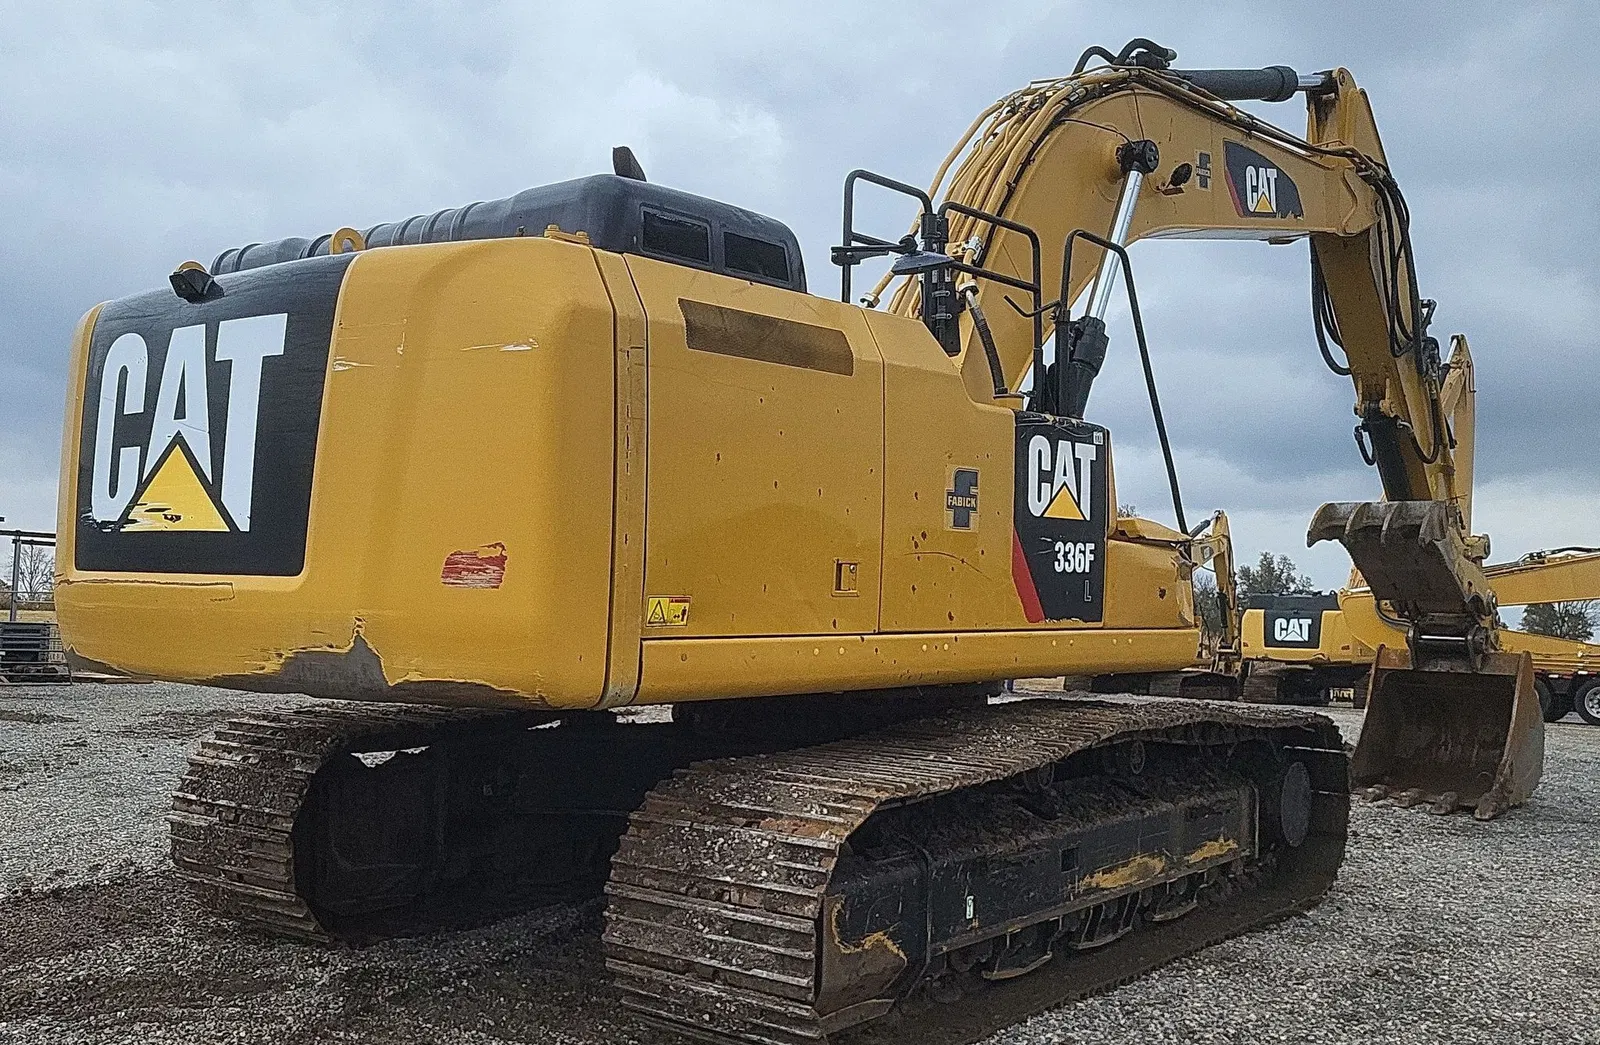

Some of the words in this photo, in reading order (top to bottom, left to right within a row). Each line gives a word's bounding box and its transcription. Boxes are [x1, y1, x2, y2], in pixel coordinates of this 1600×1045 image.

[1245, 166, 1278, 213] CAT
[90, 313, 288, 532] CAT
[1028, 435, 1096, 521] CAT
[948, 495, 976, 507] FABICK
[1054, 542, 1095, 573] 336F
[1084, 580, 1092, 601] L
[1275, 618, 1311, 641] CAT
